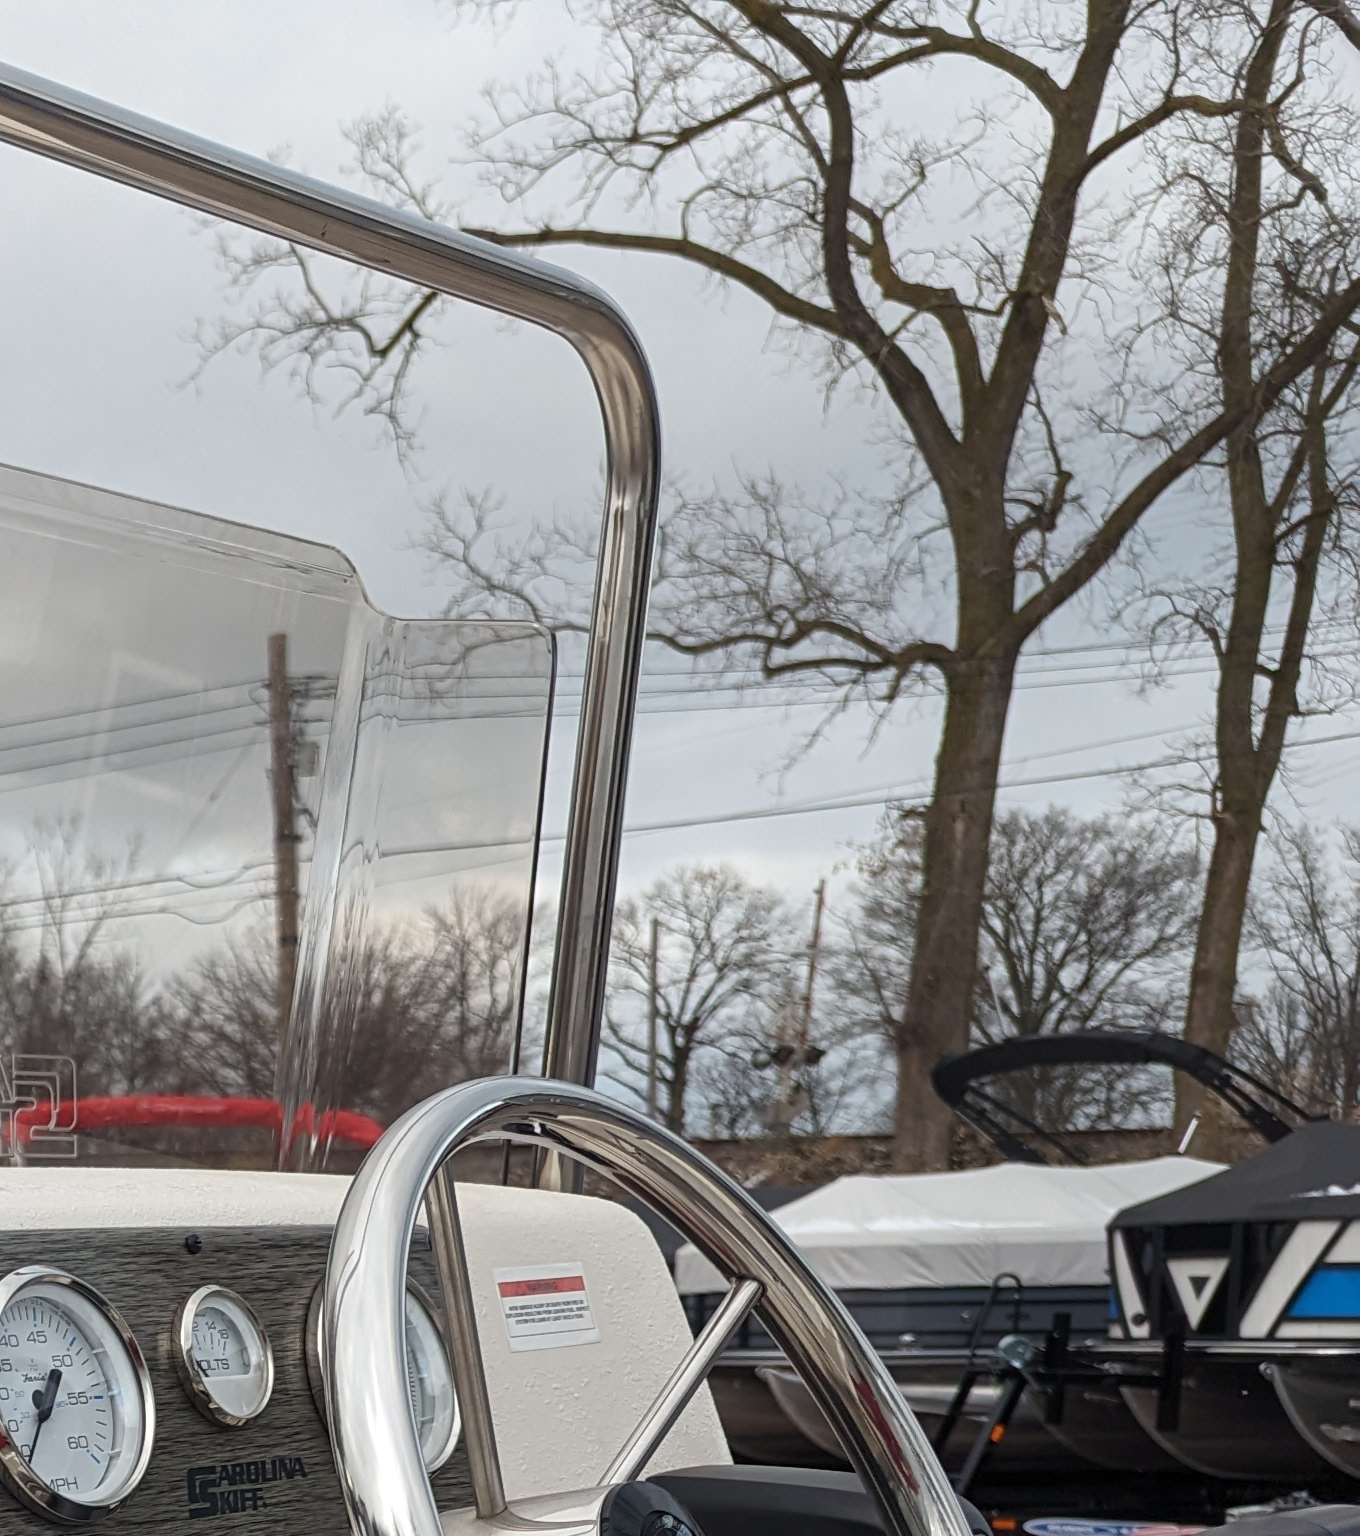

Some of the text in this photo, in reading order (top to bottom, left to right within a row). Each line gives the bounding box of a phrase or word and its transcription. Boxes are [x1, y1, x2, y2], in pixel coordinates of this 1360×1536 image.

[205, 1321, 216, 1330] 14
[27, 1331, 47, 1343] 45
[51, 1354, 73, 1367] 50
[67, 1391, 89, 1405] 55
[8, 1419, 19, 1432] 0
[67, 1436, 89, 1449] 60
[186, 1457, 307, 1503] CAROLINA
[189, 1480, 265, 1519] SKIFF
